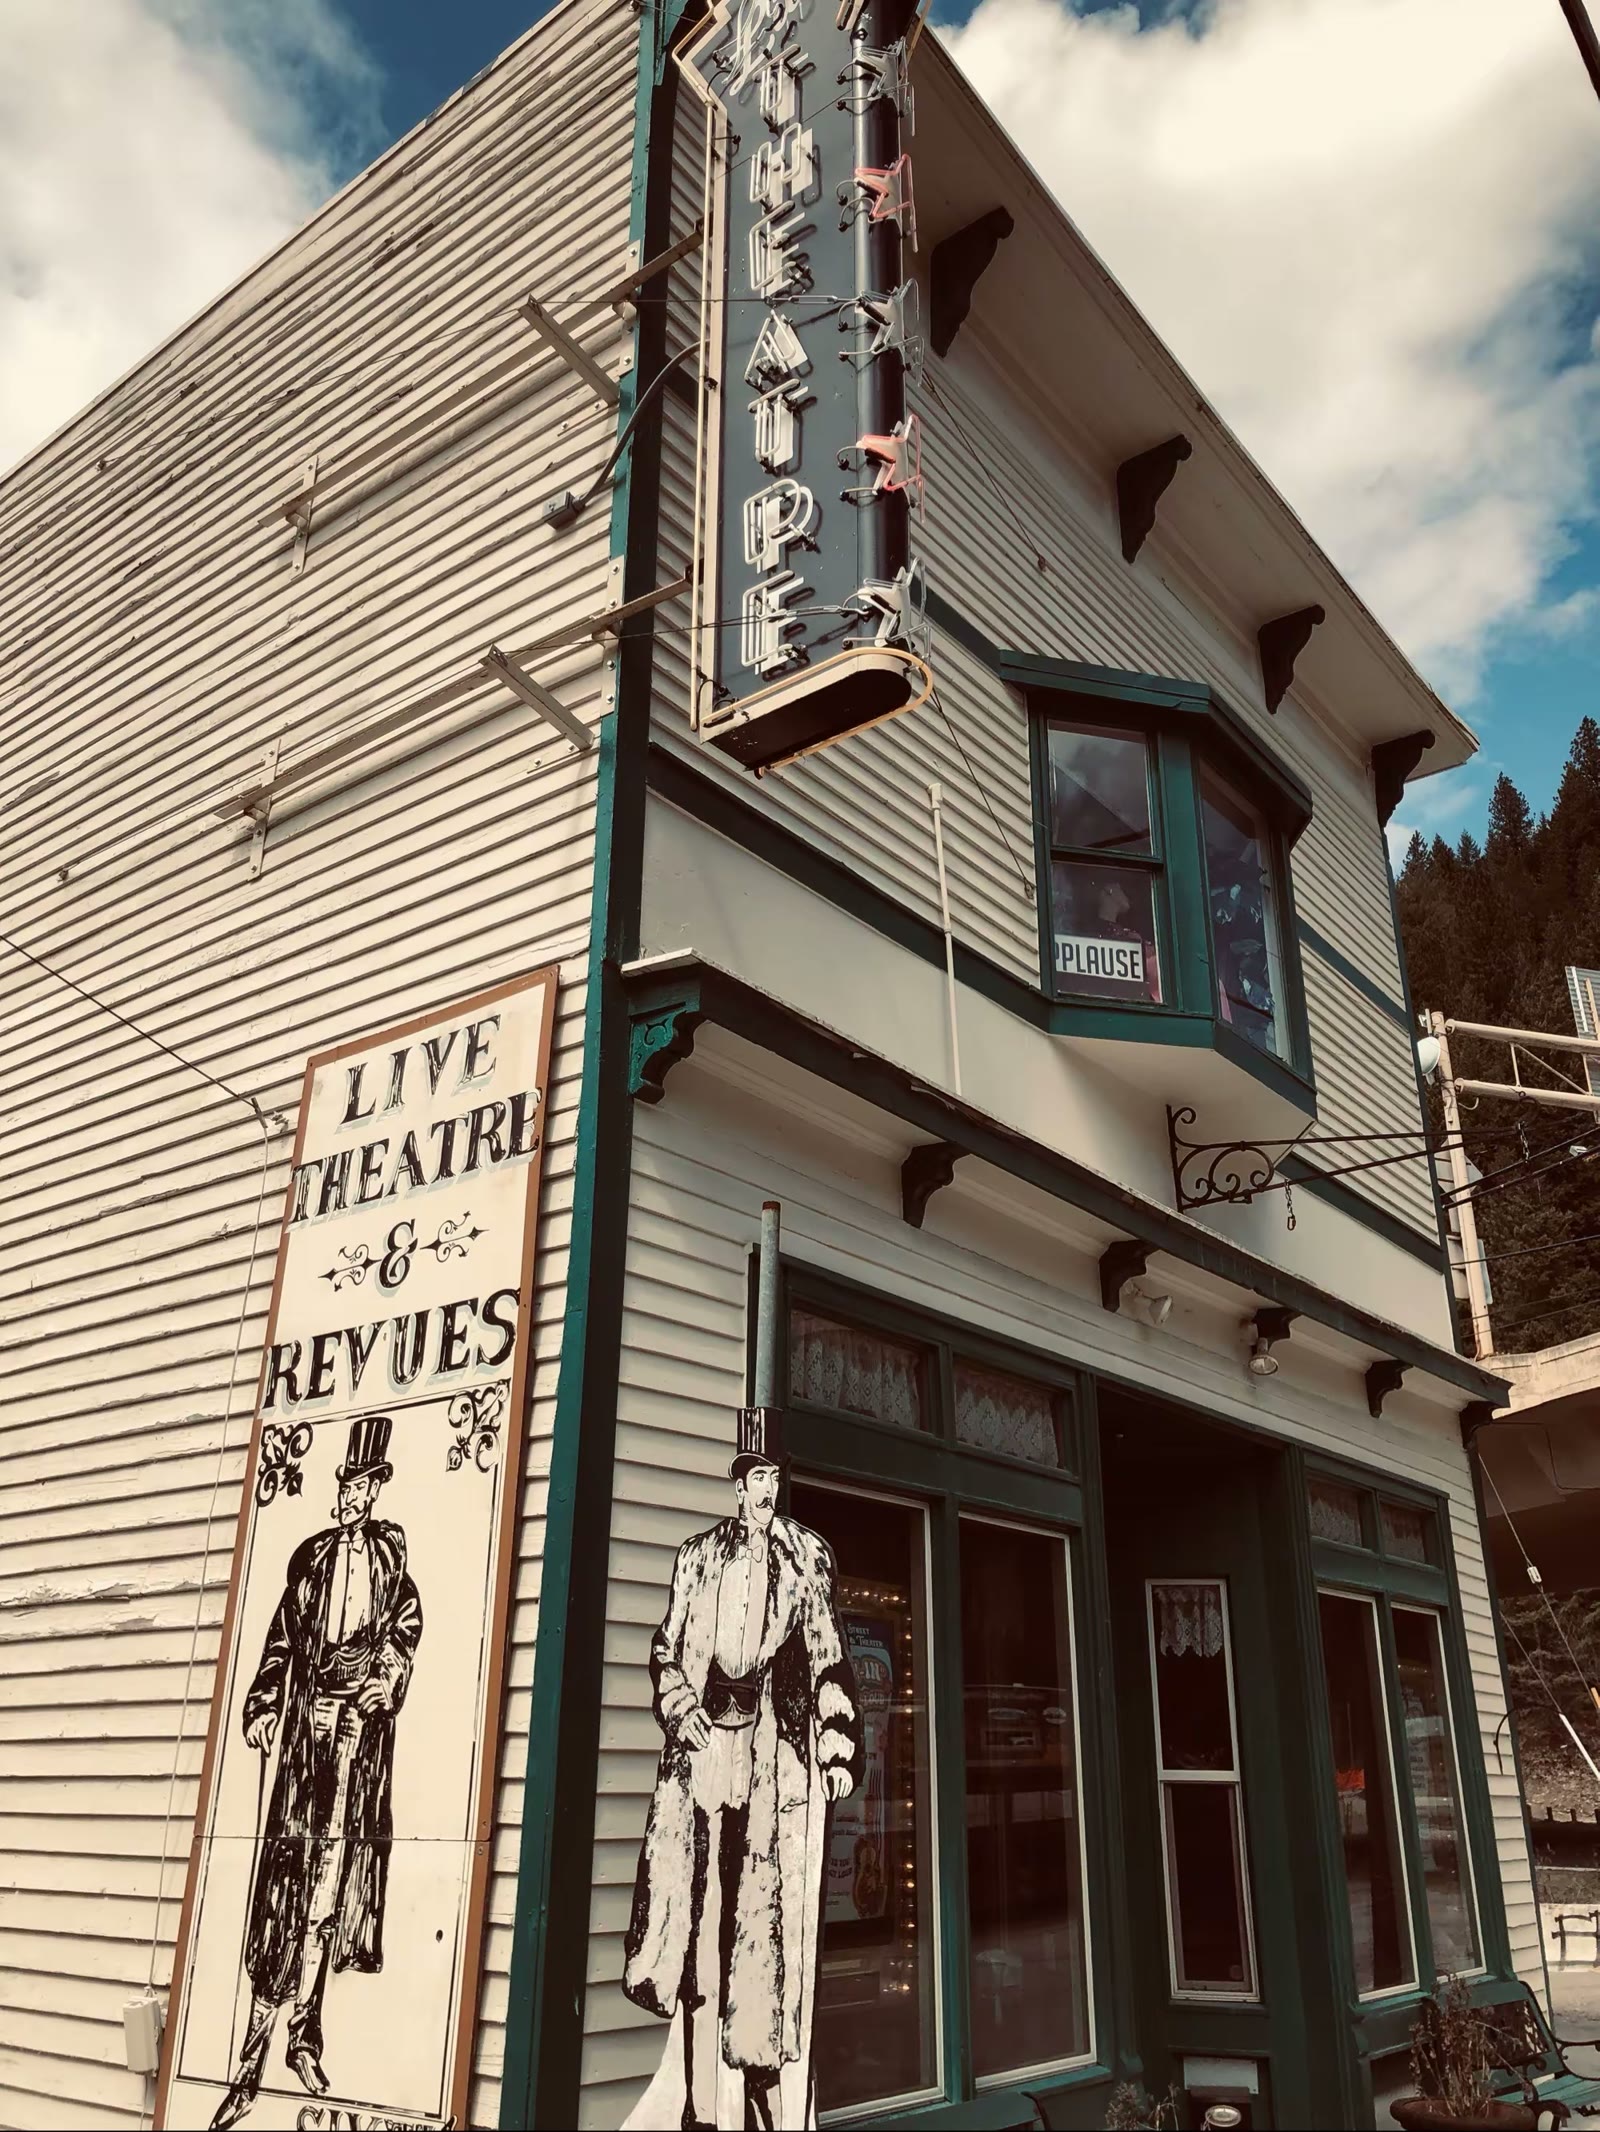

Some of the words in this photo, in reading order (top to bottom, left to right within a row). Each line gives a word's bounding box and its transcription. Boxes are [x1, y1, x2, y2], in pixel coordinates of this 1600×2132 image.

[741, 44, 816, 676] THEATRE
[339, 1013, 501, 1126] LIVE
[289, 1086, 543, 1226] THEATRE
[378, 1217, 419, 1289] &
[261, 1286, 522, 1411] REVUES
